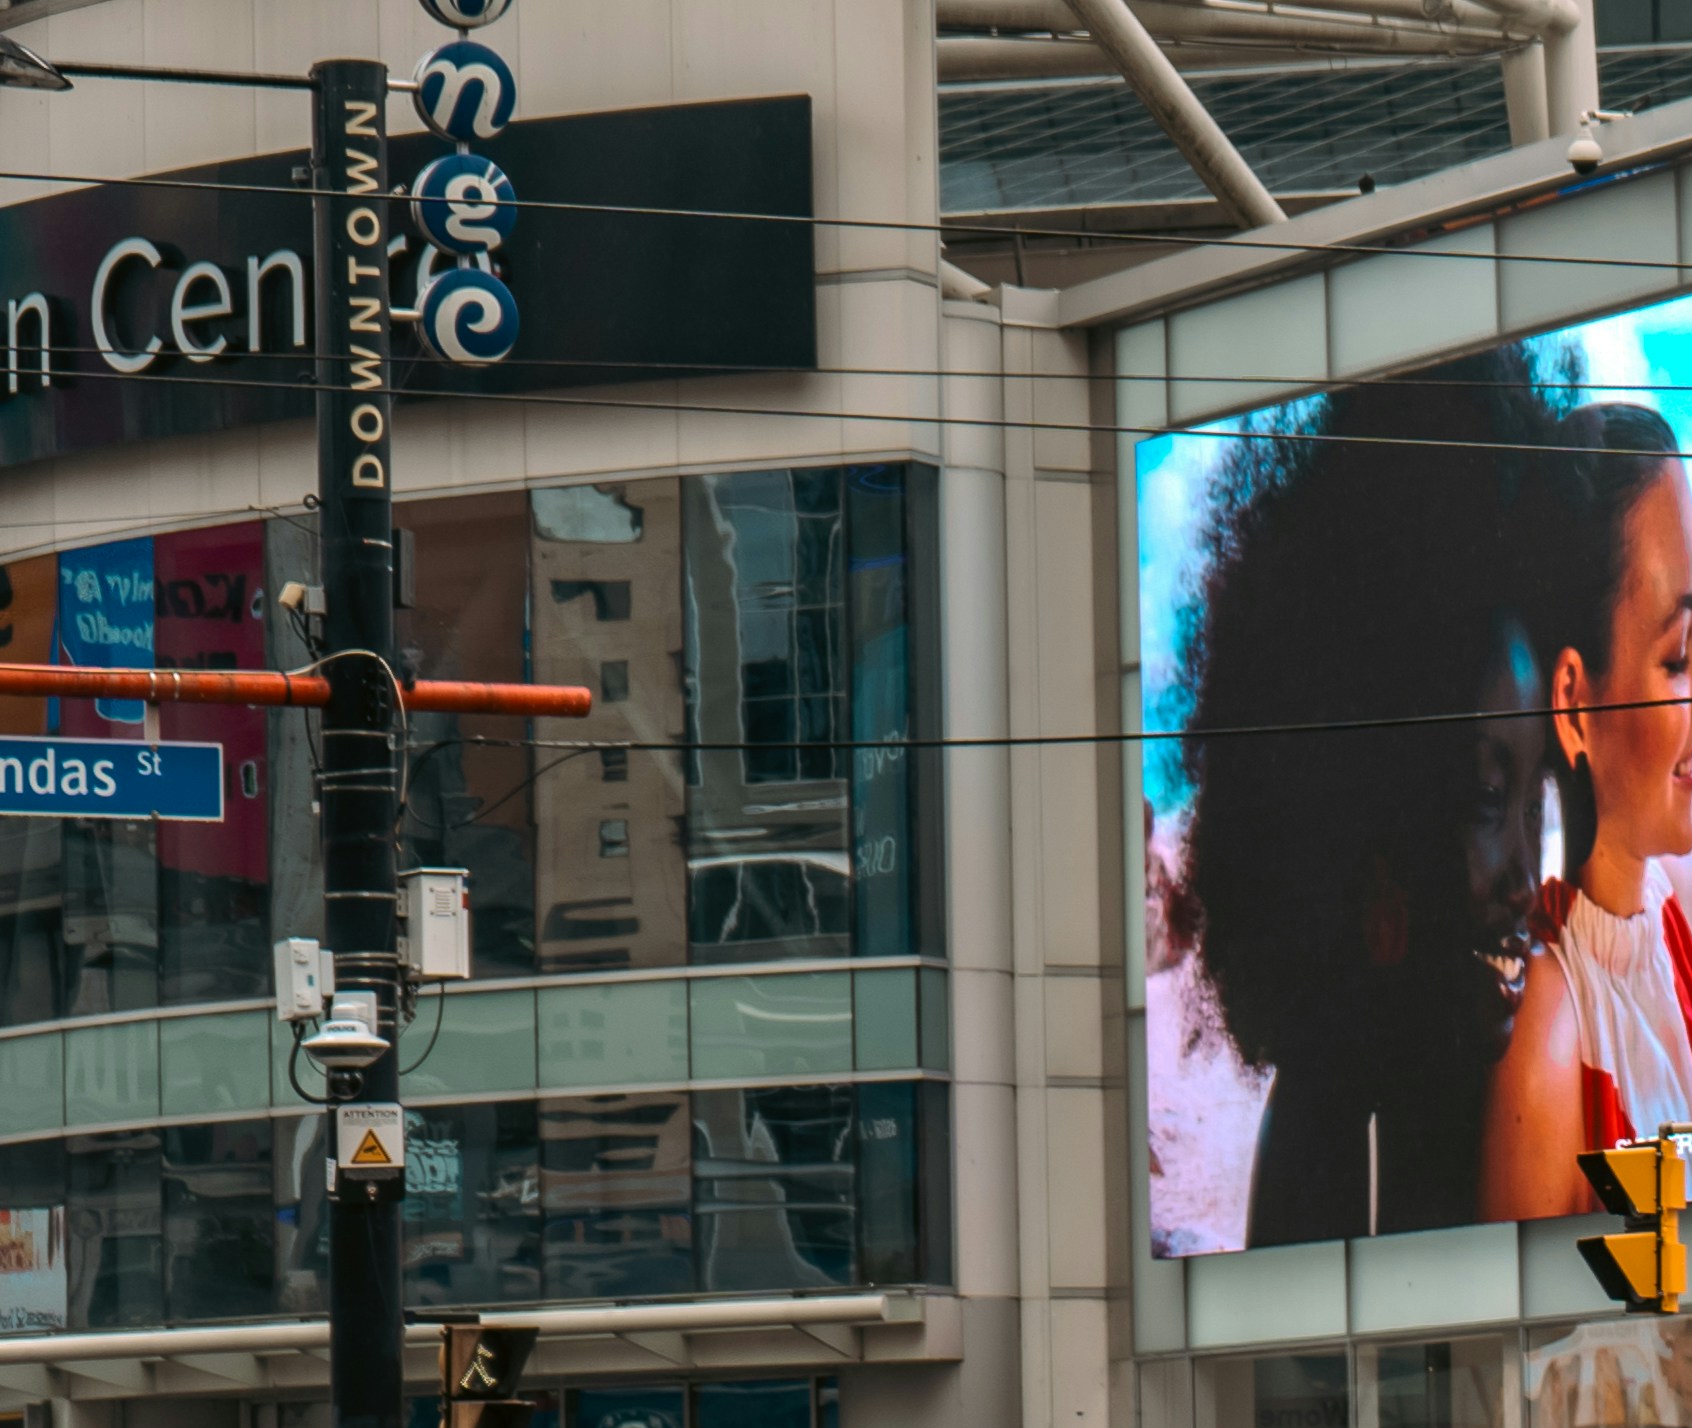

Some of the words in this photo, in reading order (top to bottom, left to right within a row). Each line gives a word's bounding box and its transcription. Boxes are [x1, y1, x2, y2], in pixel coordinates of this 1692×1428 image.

[420, 0, 508, 366] nge
[344, 98, 385, 488] DOWNTOWN
[137, 751, 162, 776] St
[343, 1110, 399, 1119] ATTENTION
